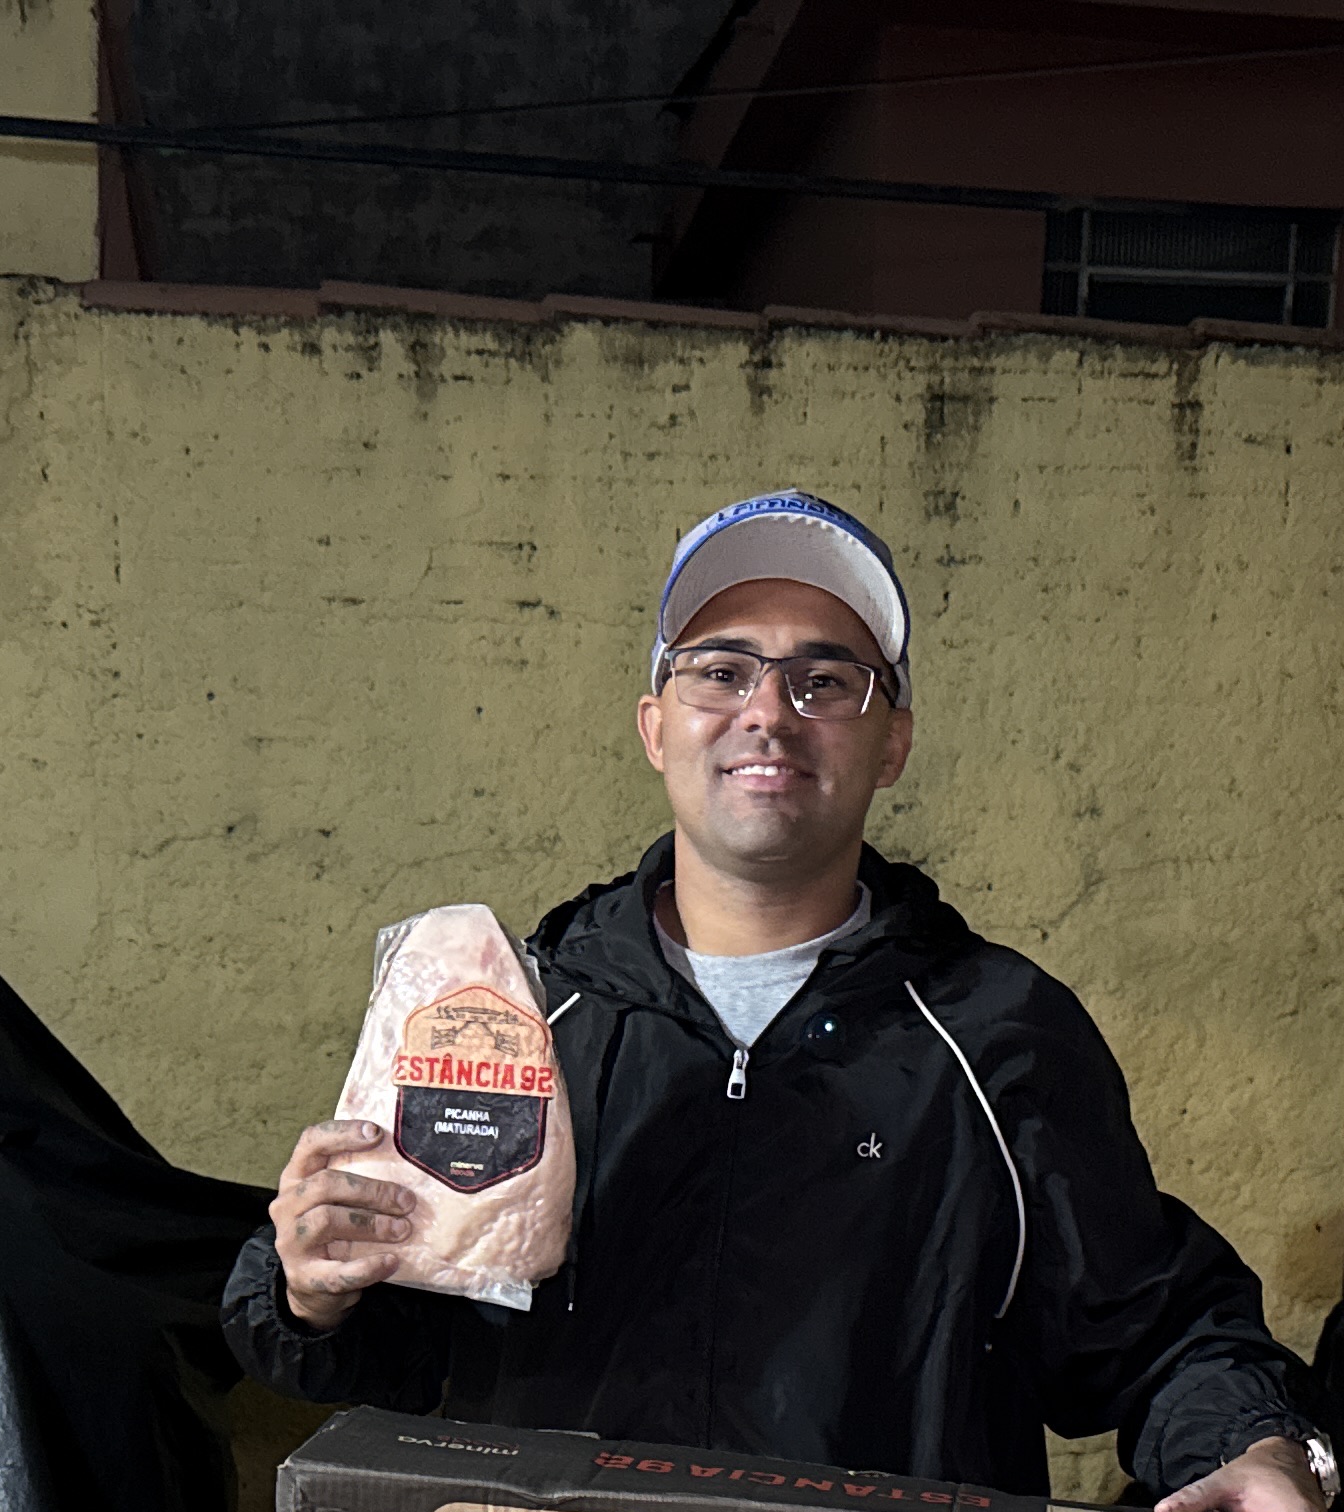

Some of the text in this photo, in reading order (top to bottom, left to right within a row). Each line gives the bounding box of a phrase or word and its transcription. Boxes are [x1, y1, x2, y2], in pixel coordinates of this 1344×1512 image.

[444, 1107, 491, 1122] PICANHA
[434, 1121, 499, 1139] (MATURADA)
[856, 1132, 883, 1159] ck
